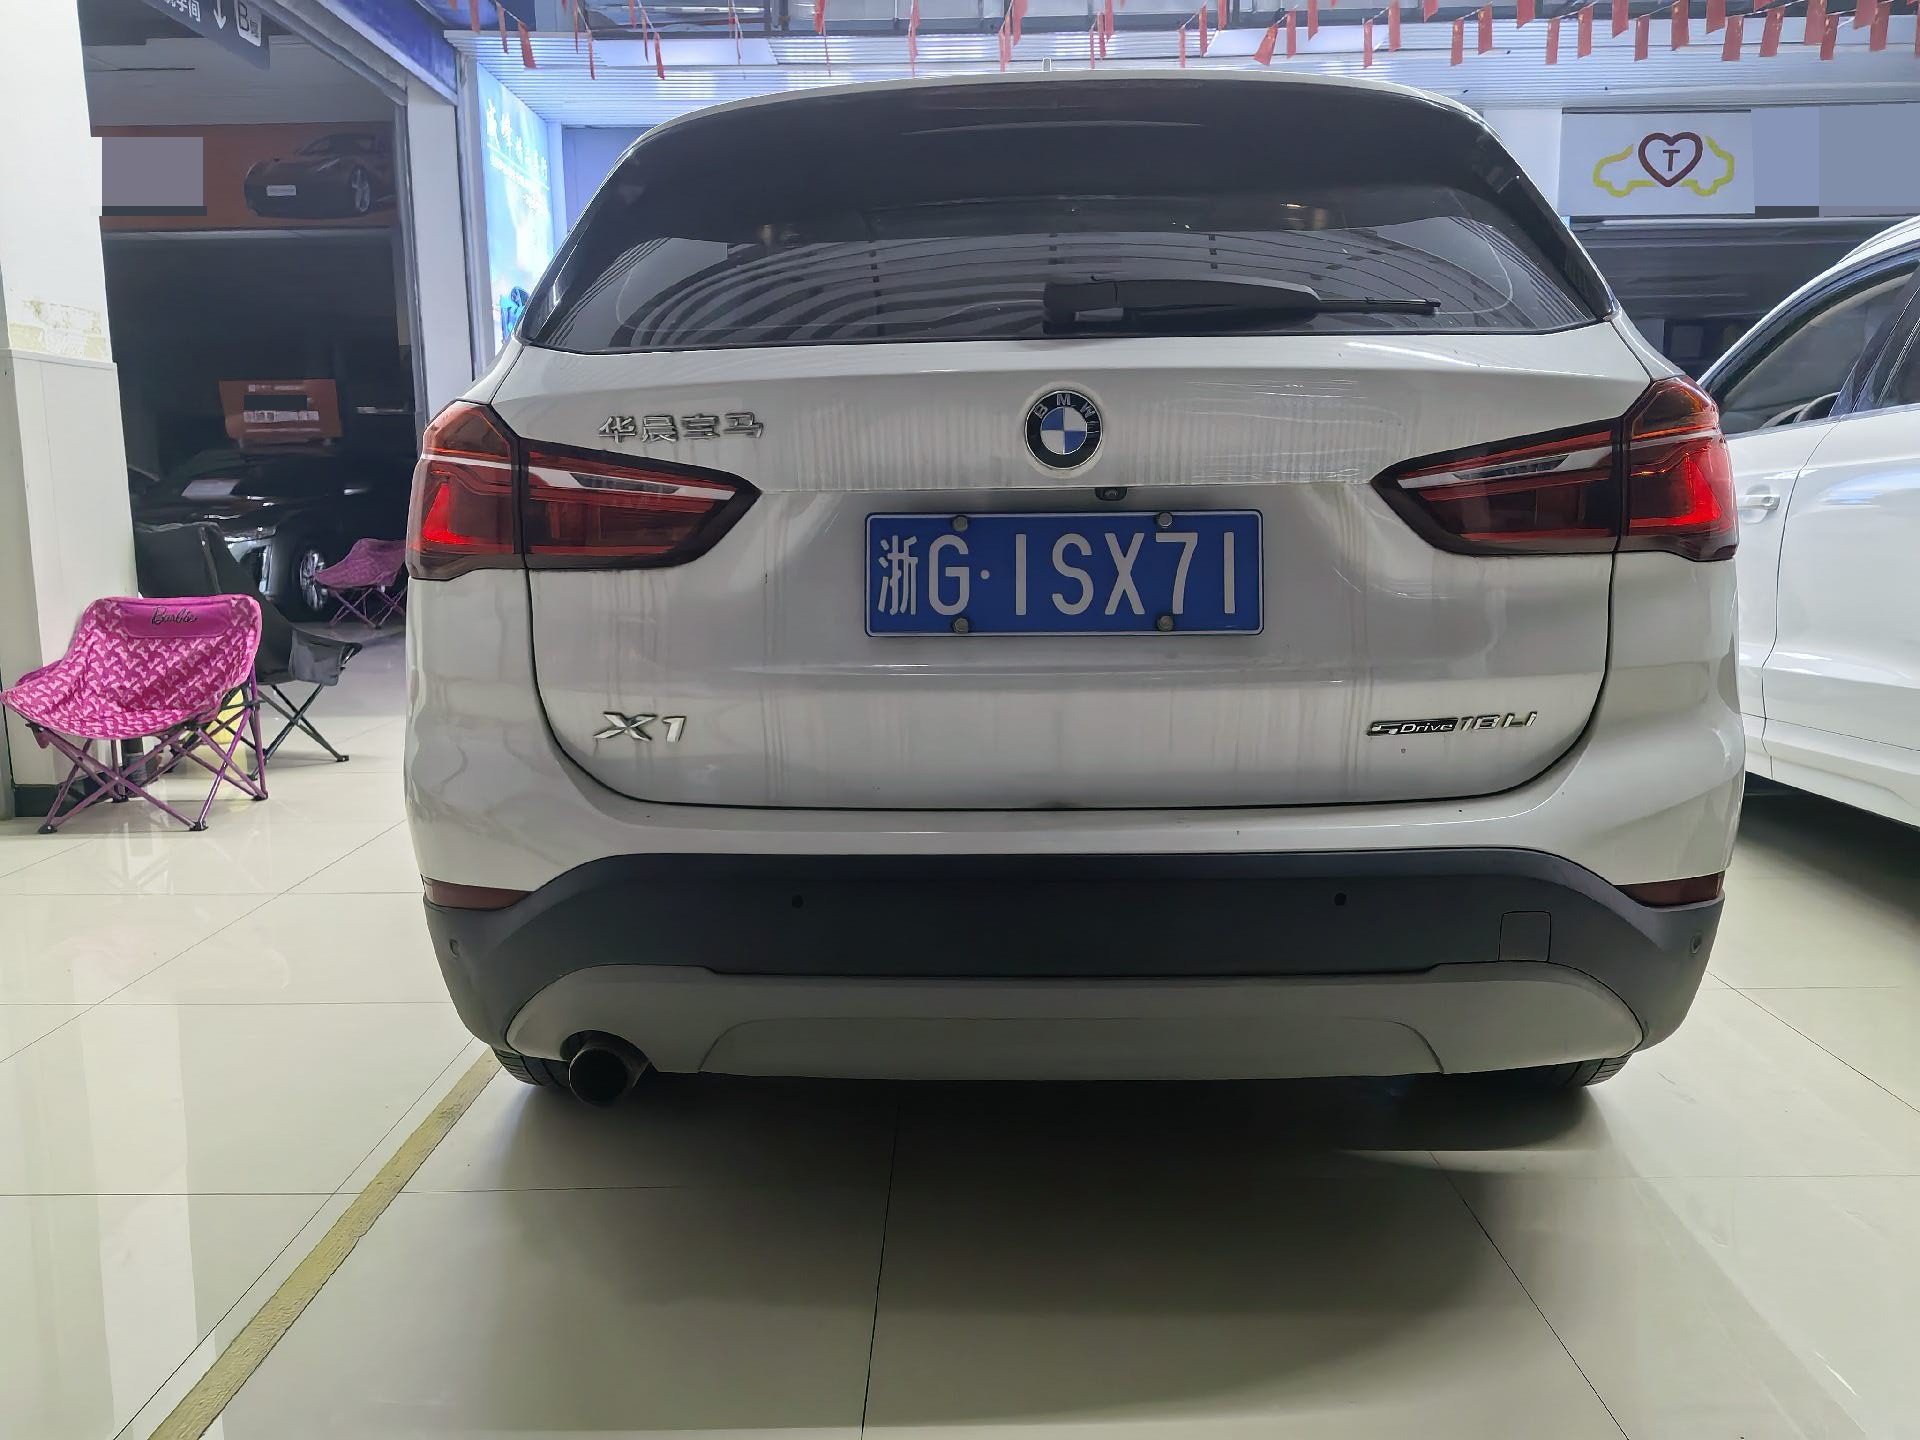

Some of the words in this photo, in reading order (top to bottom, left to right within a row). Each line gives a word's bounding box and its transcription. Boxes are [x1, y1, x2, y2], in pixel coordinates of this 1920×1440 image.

[1662, 149, 1681, 172] T
[1032, 393, 1096, 419] BMW
[597, 412, 764, 444] 华晨宝马
[152, 606, 199, 625] Barbie
[592, 711, 687, 743] X1
